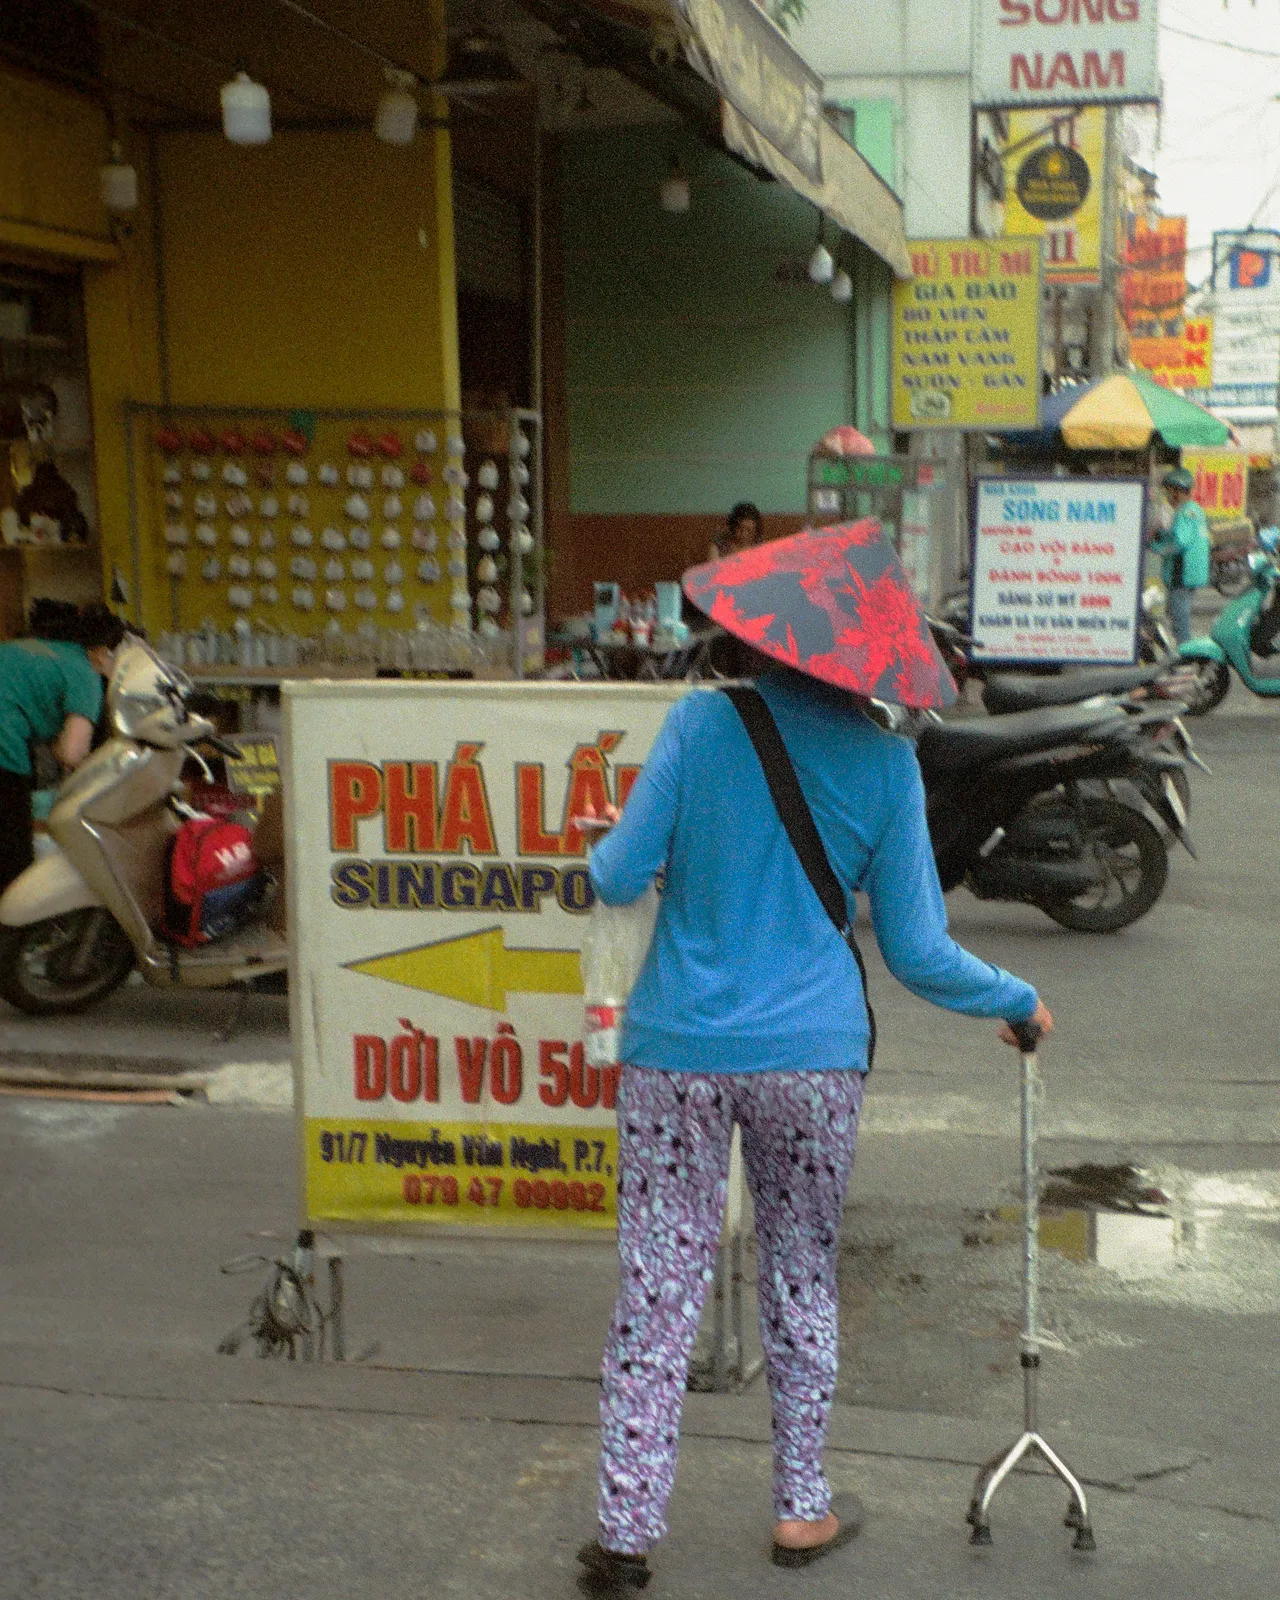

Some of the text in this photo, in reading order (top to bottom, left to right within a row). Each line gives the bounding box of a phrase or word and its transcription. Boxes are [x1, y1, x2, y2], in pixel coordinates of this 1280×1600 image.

[1010, 50, 1126, 92] NAM
[902, 352, 950, 366] NAM
[1003, 499, 1116, 523] SONG NAM
[327, 730, 644, 857] PHÁ LẤ
[331, 858, 597, 914] SINGAPO
[353, 1017, 440, 1103] DỜI
[454, 1021, 524, 1104] VÔ
[320, 1130, 368, 1165] 91/7
[374, 1127, 456, 1168] Nguyễn
[461, 1133, 504, 1168] Văn
[402, 1174, 606, 1212] 079 47 99992
